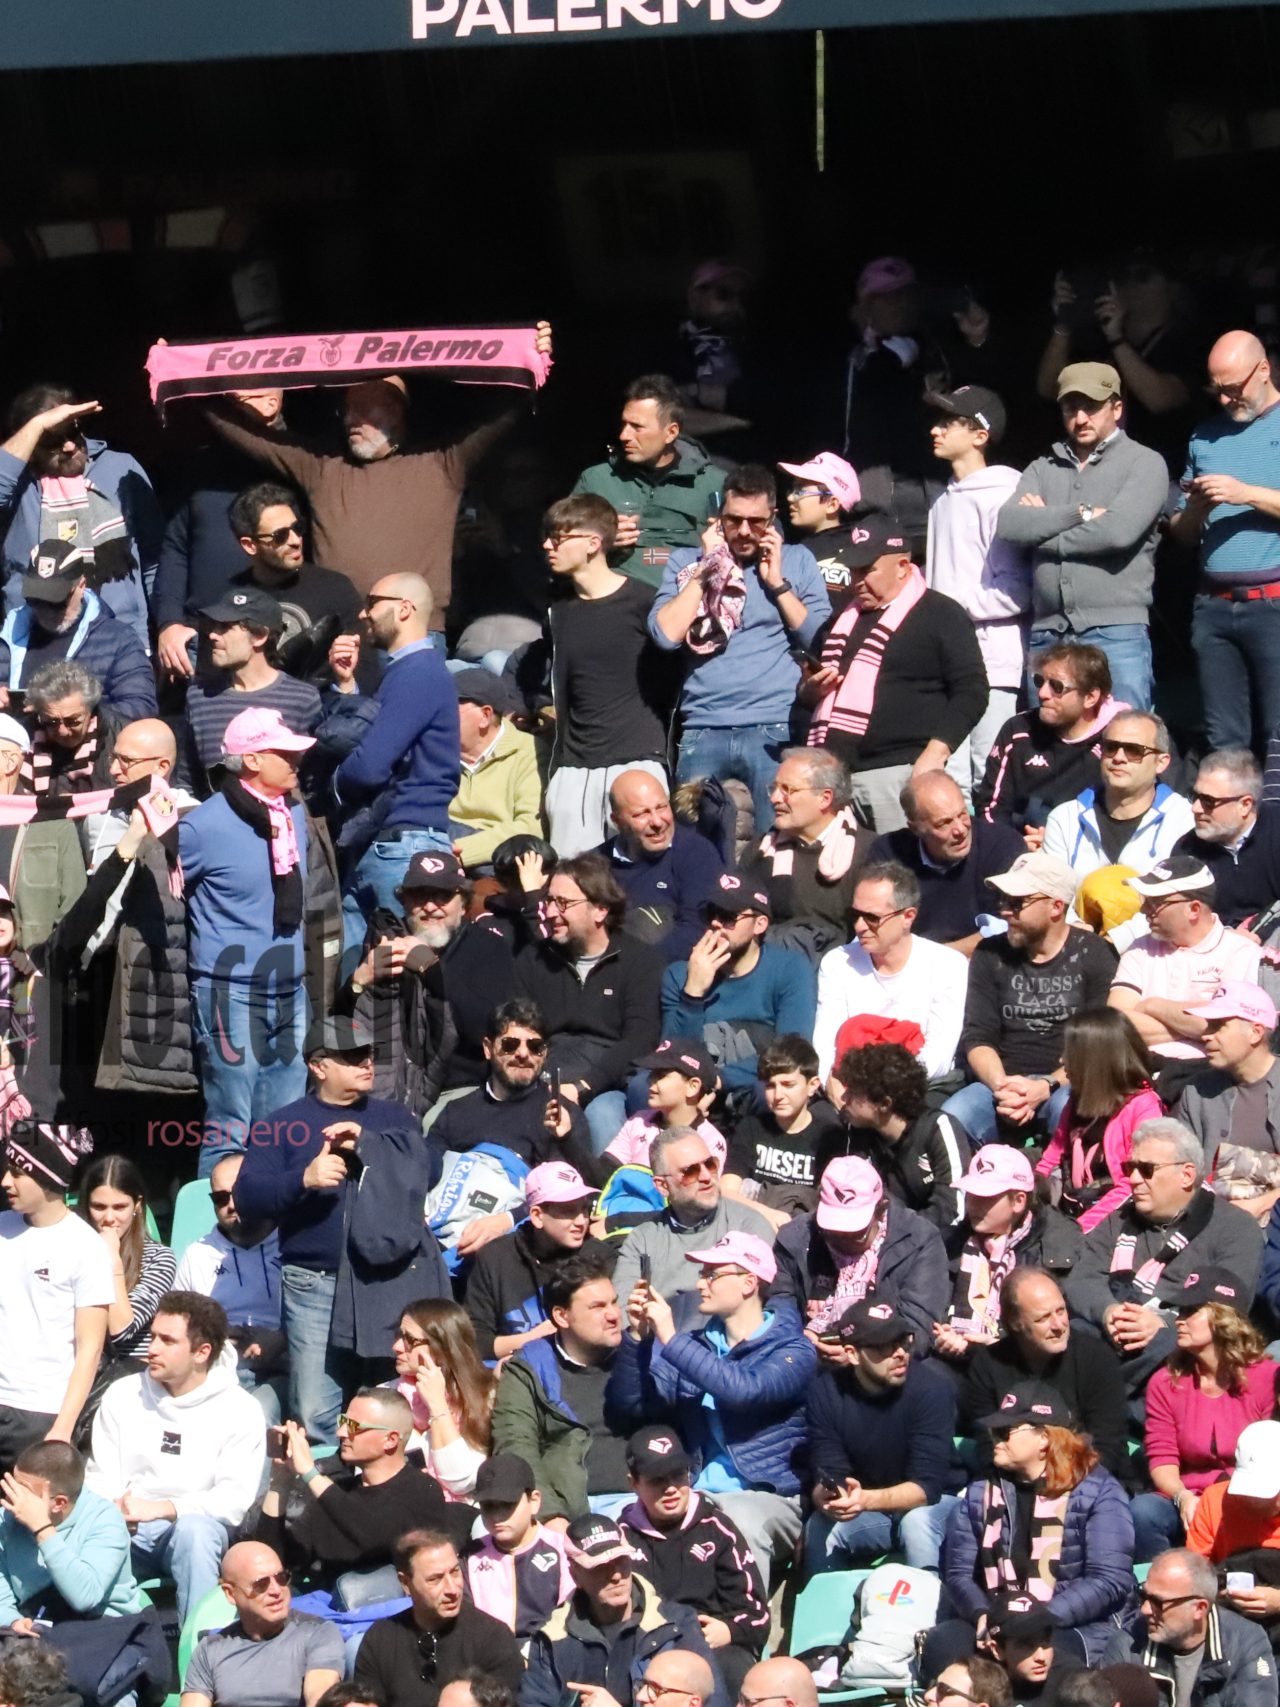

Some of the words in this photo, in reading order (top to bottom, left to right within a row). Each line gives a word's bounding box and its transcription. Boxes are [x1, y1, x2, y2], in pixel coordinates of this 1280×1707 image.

[206, 345, 306, 372] Forza
[353, 334, 504, 364] Palermo
[755, 1144, 814, 1181] DIESEL
